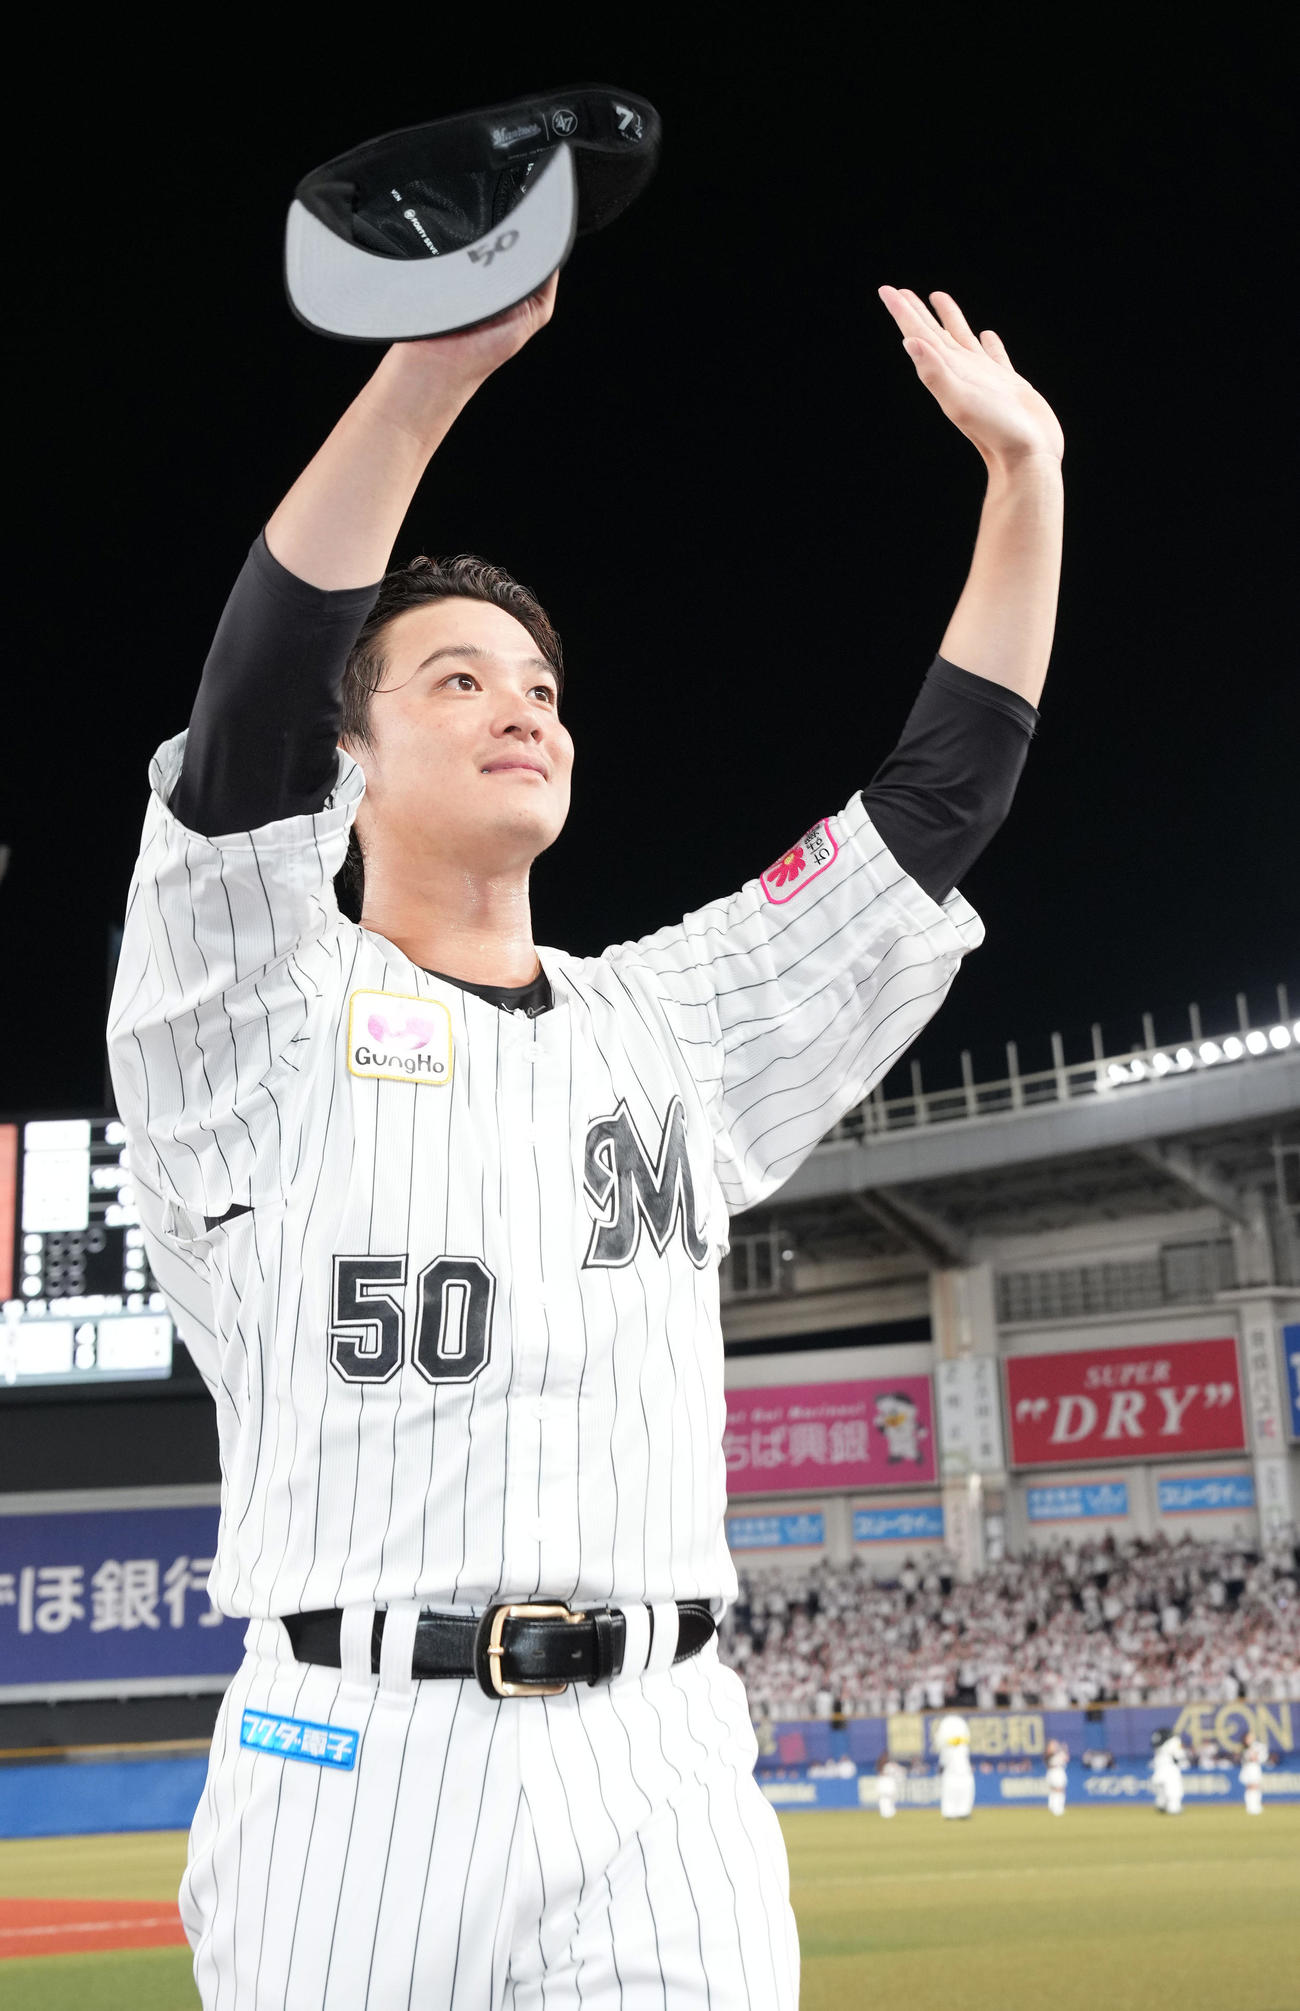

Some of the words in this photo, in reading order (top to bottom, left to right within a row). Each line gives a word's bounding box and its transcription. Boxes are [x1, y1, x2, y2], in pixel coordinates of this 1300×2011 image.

[411, 217, 427, 238] FORTY
[423, 237, 440, 255] SEVE
[467, 230, 520, 267] 50
[355, 1047, 445, 1075] GungHo
[329, 1253, 497, 1385] 50
[1084, 1359, 1172, 1390] SUPER
[0, 1555, 224, 1634] ほ銀行
